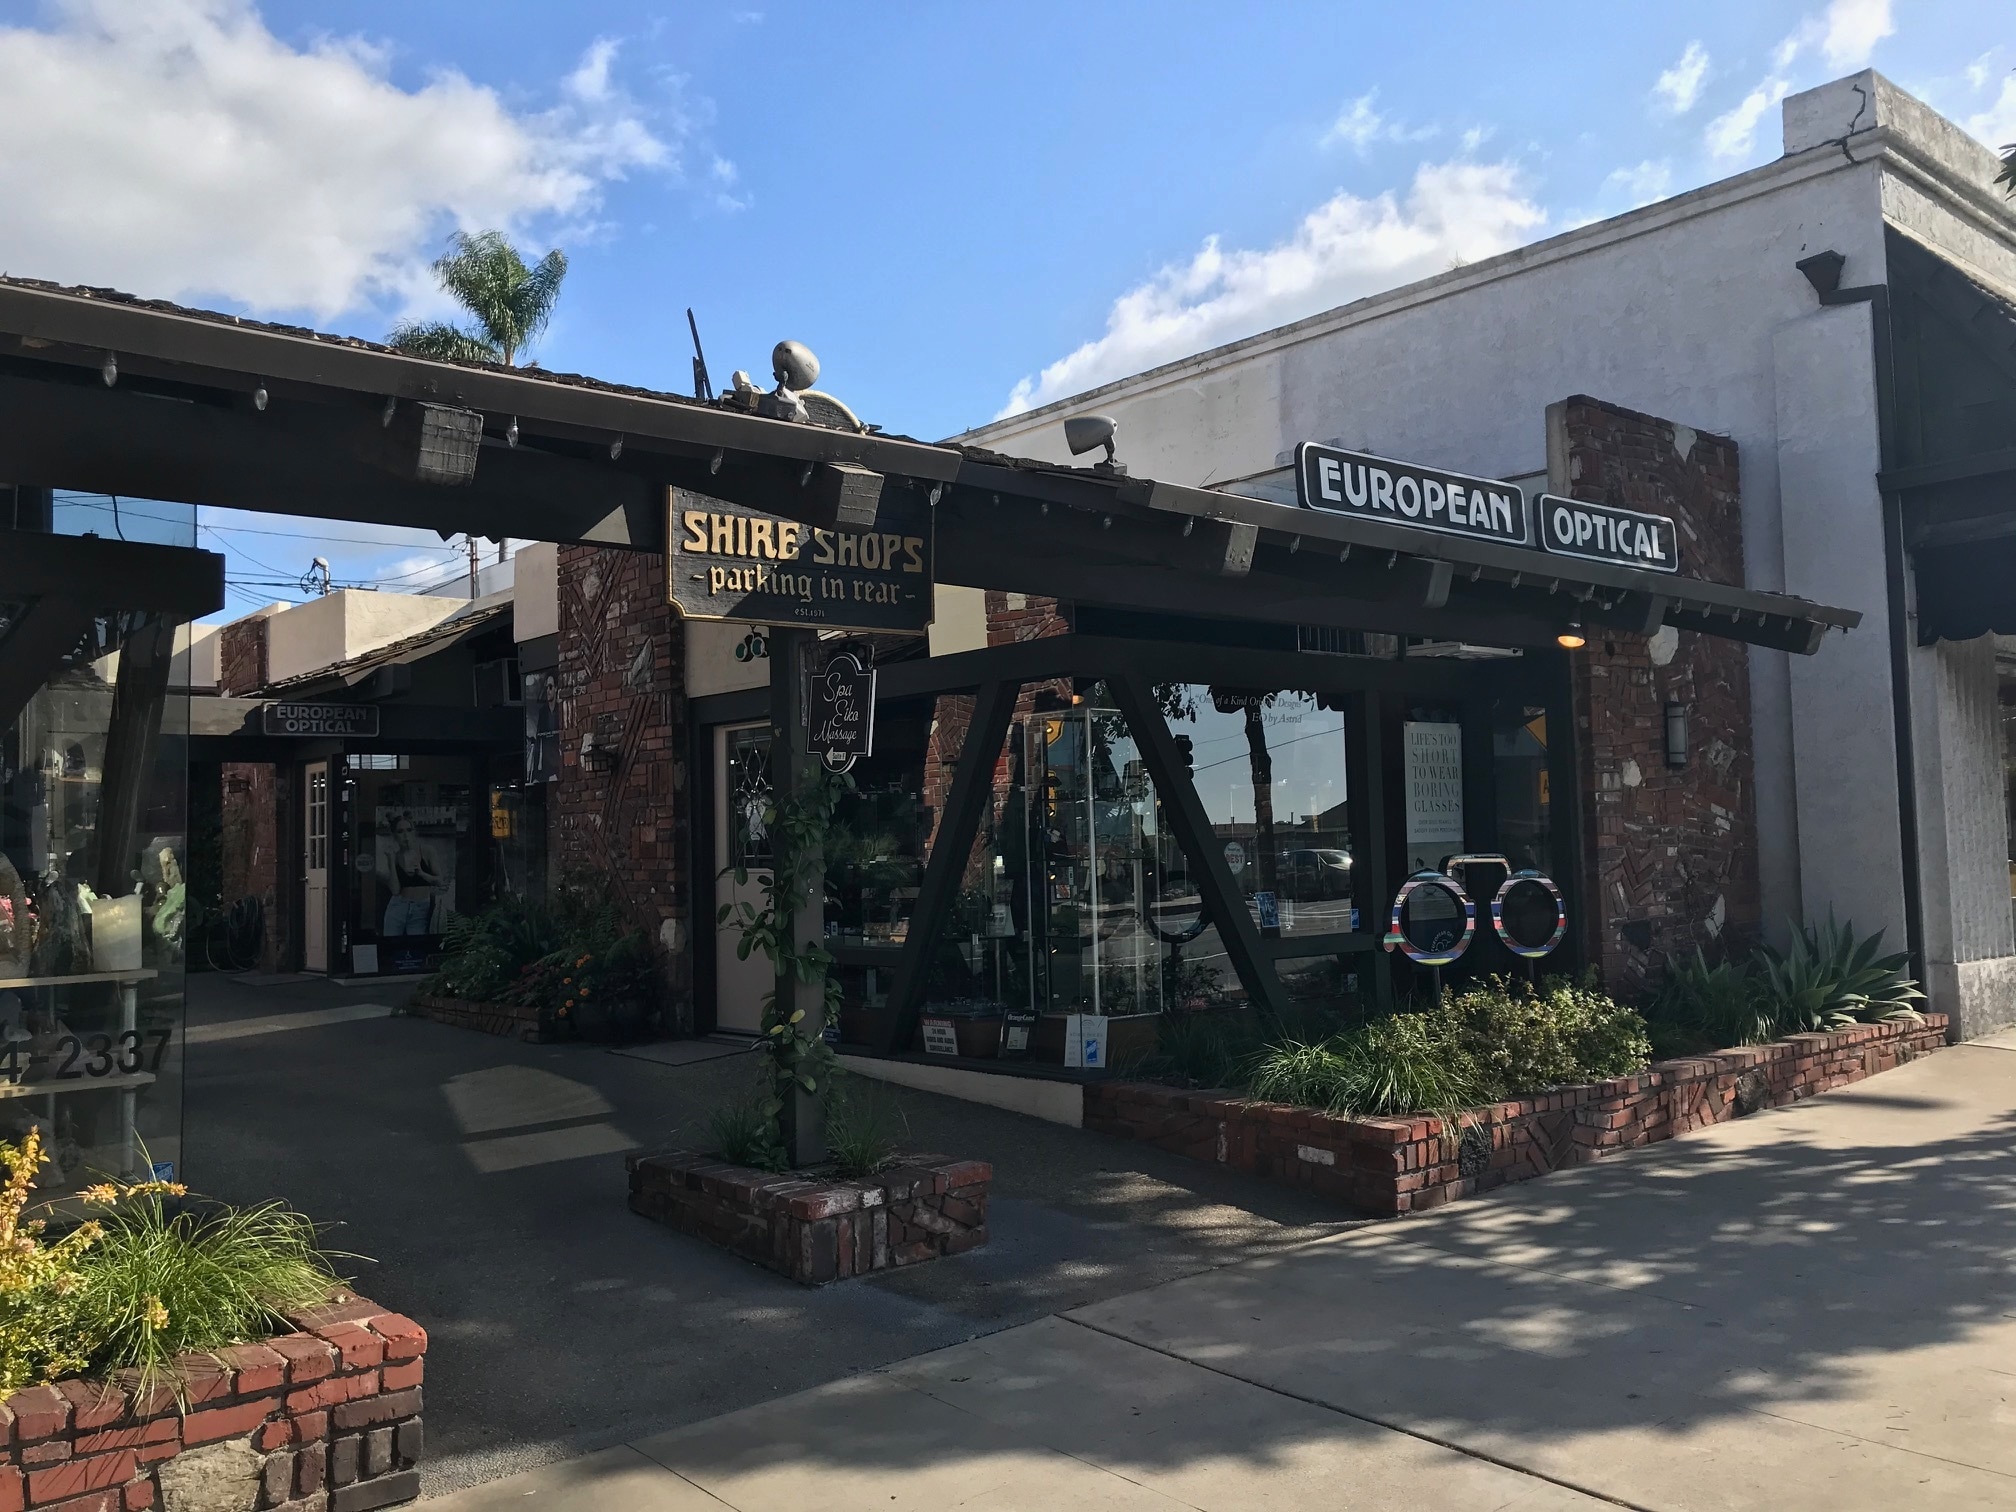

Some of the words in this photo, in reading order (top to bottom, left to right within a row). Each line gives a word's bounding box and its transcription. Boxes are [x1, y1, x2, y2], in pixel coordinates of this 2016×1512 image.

[1317, 456, 1514, 534] EUROPEAN
[1553, 507, 1666, 561] OPTICAL
[683, 511, 800, 560] SHIRE
[813, 527, 924, 573] SHOPS
[821, 570, 846, 600] in
[822, 672, 853, 702] Spa
[1230, 695, 1247, 707] Kind
[276, 705, 367, 720] EUROPEAN
[1268, 713, 1278, 724] by
[1279, 713, 1302, 724] Astrid
[285, 719, 356, 733] OPTICAL
[814, 720, 857, 745] Massage
[1439, 734, 1457, 746] TOO
[1412, 748, 1457, 764] SHORT
[1412, 766, 1427, 780] TO
[1429, 766, 1459, 780] WEAR
[1414, 782, 1459, 798] BORING
[1414, 800, 1460, 813] GLASSES
[923, 1018, 952, 1028] WARNING
